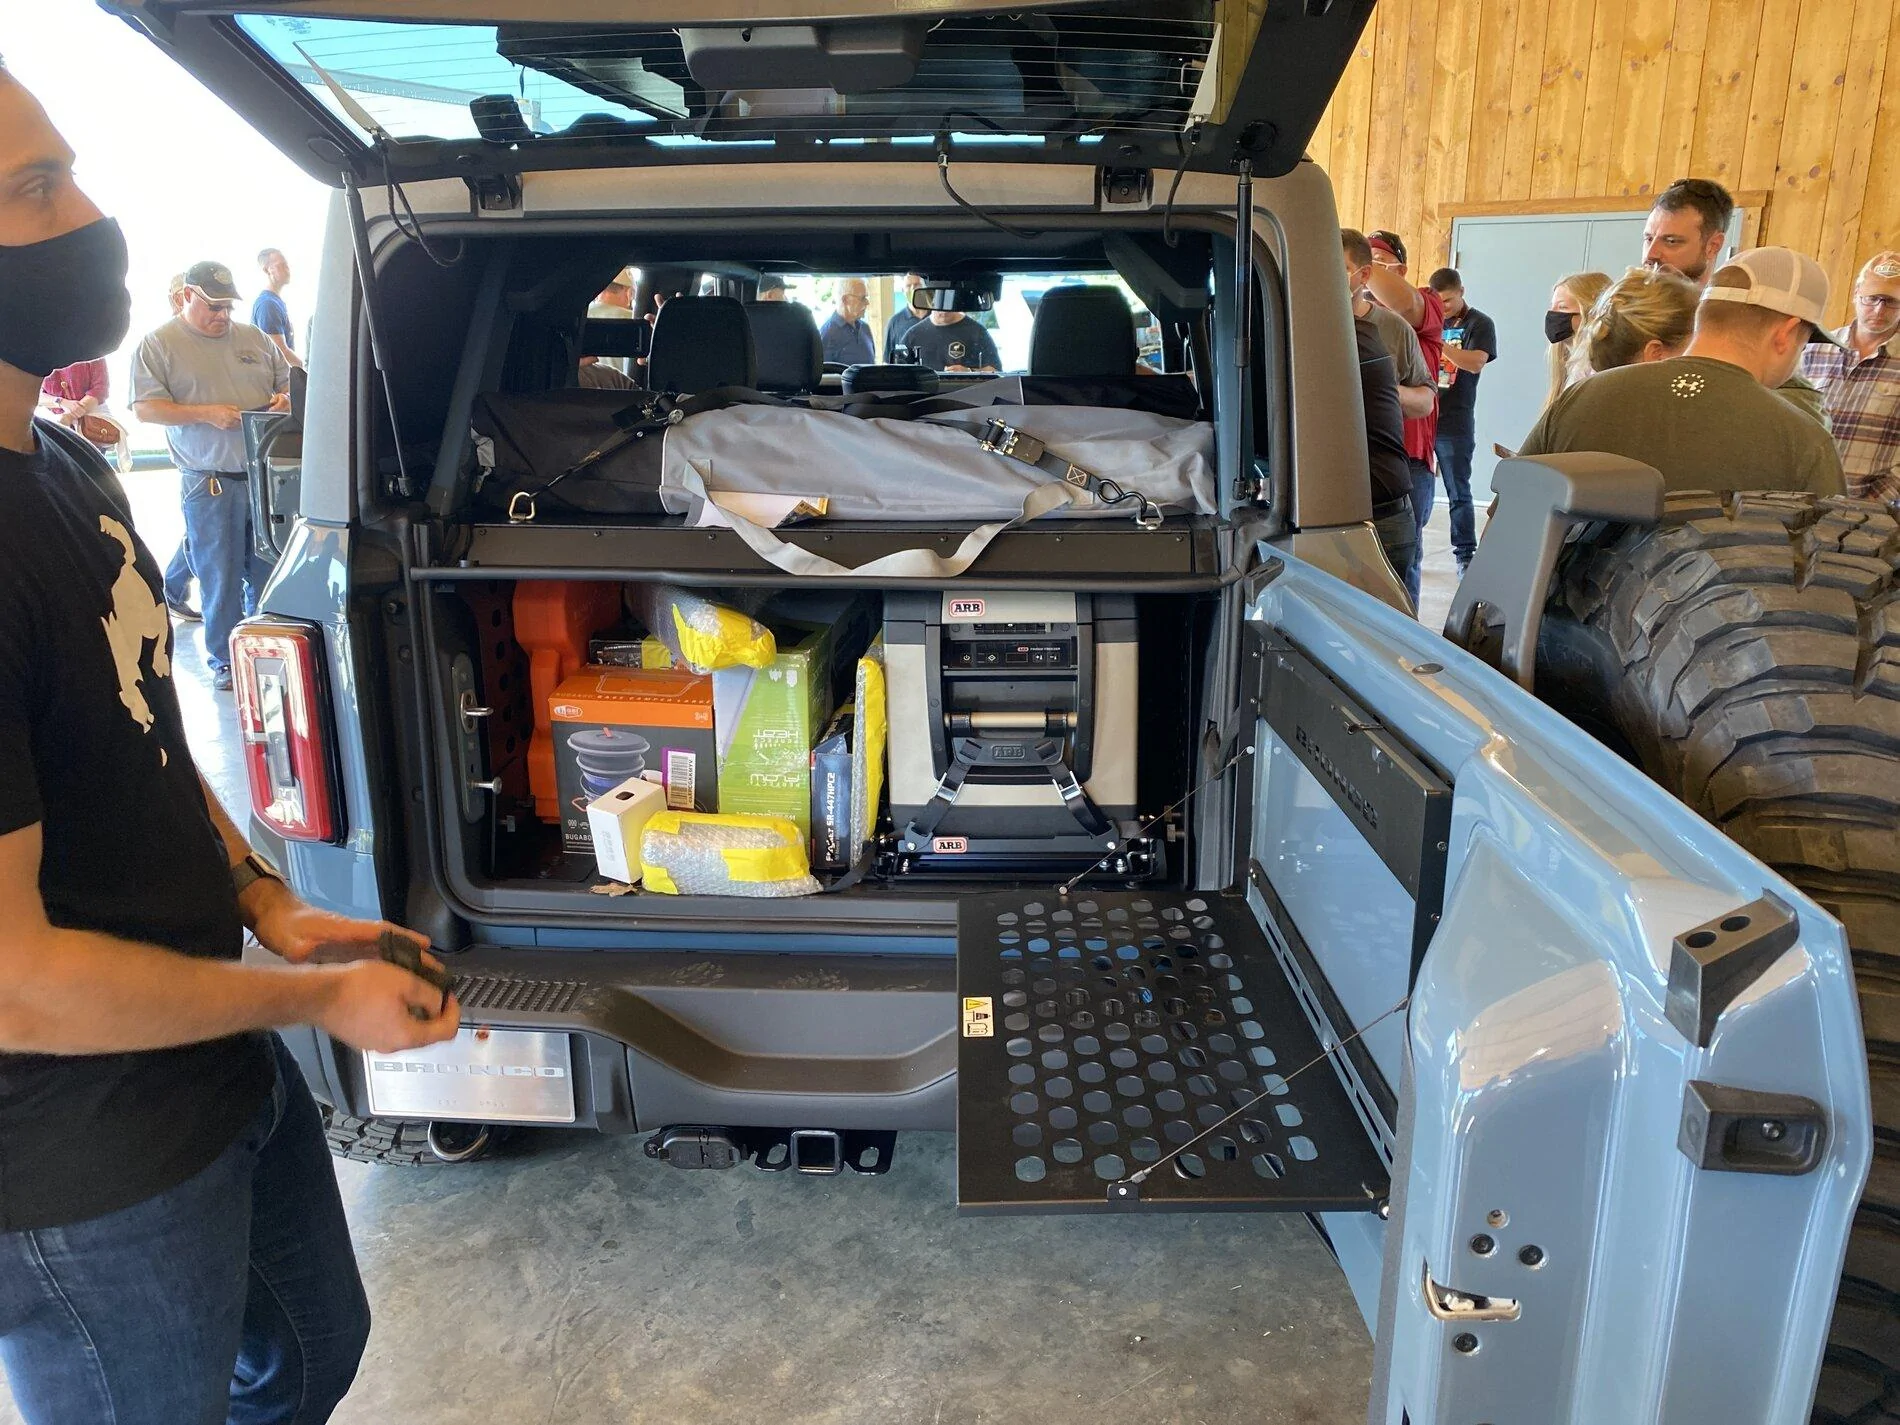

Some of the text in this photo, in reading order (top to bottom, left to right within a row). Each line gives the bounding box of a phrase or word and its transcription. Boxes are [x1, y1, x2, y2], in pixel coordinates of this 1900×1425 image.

[954, 603, 980, 613] ARB
[939, 841, 963, 850] ARB
[374, 1061, 565, 1079] BRONCO
